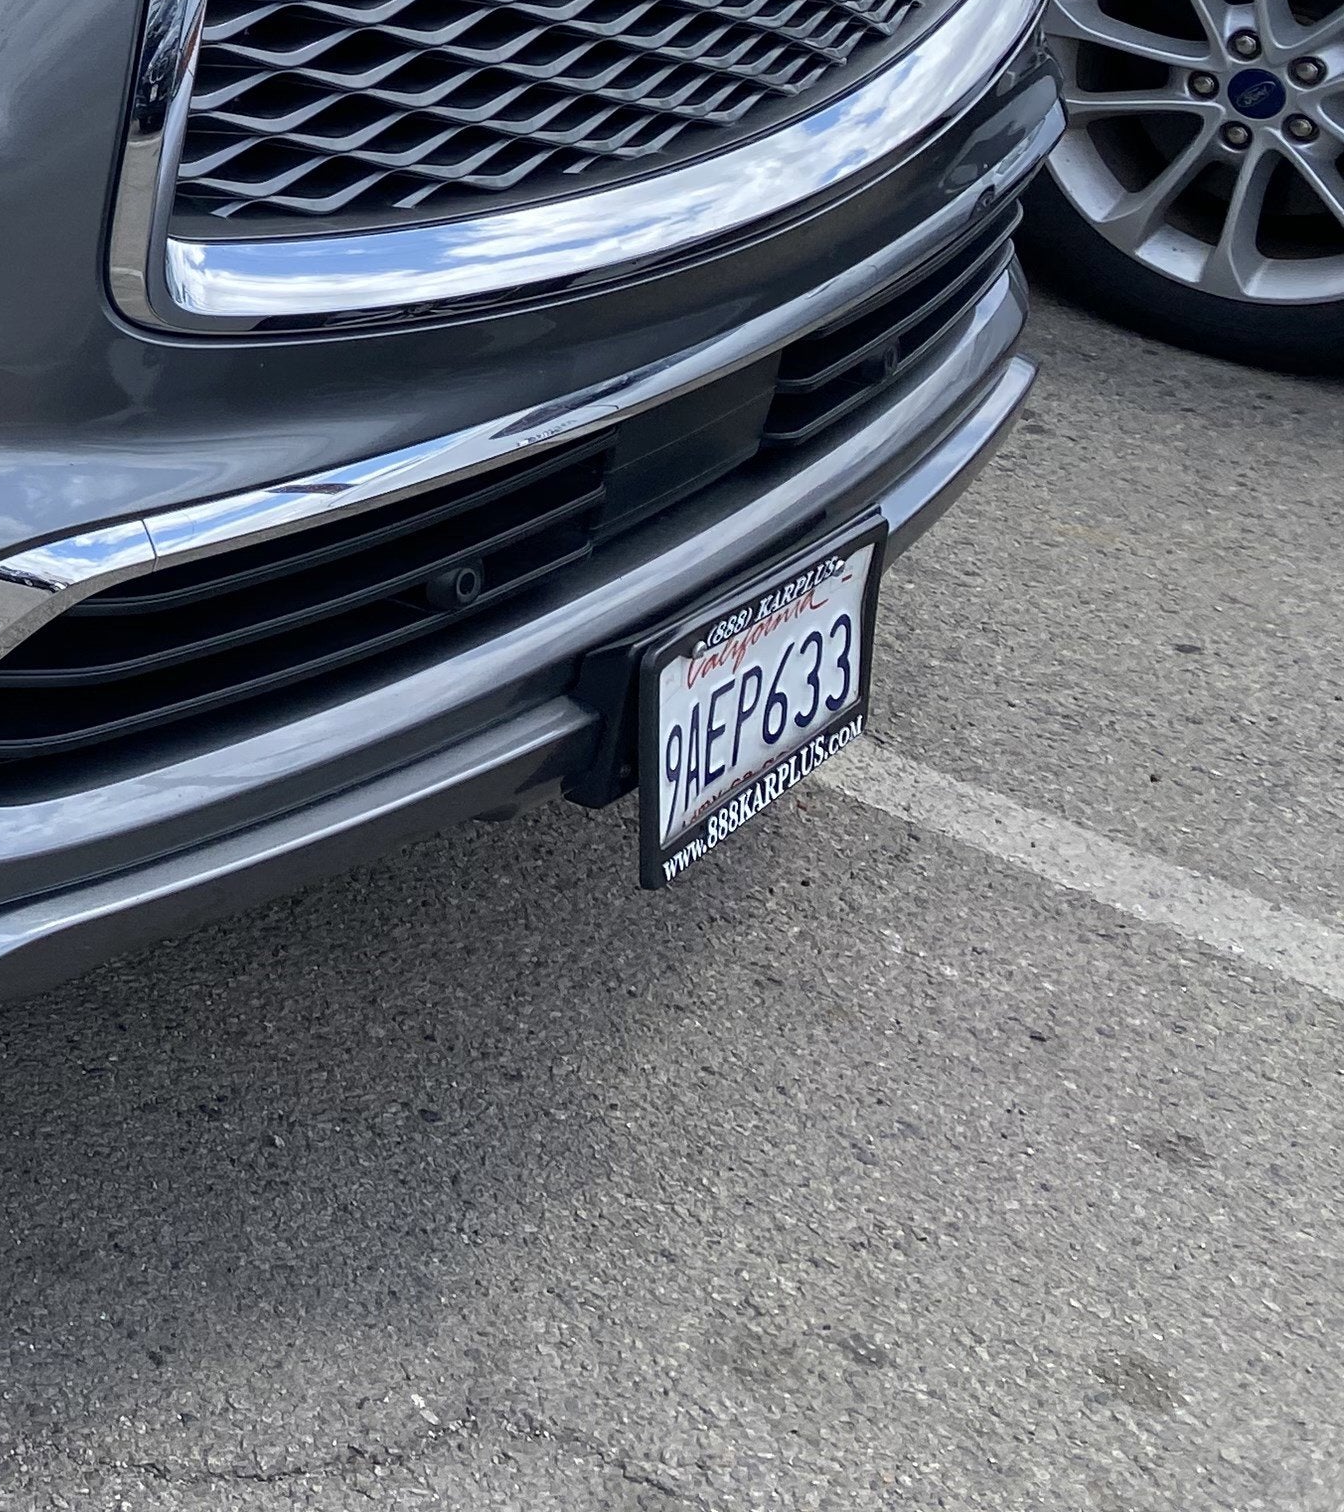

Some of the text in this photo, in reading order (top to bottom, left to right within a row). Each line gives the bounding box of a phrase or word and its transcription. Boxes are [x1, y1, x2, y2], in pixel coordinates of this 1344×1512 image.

[707, 555, 839, 648] (888) KARPLUS
[665, 613, 852, 840] 9AEP633
